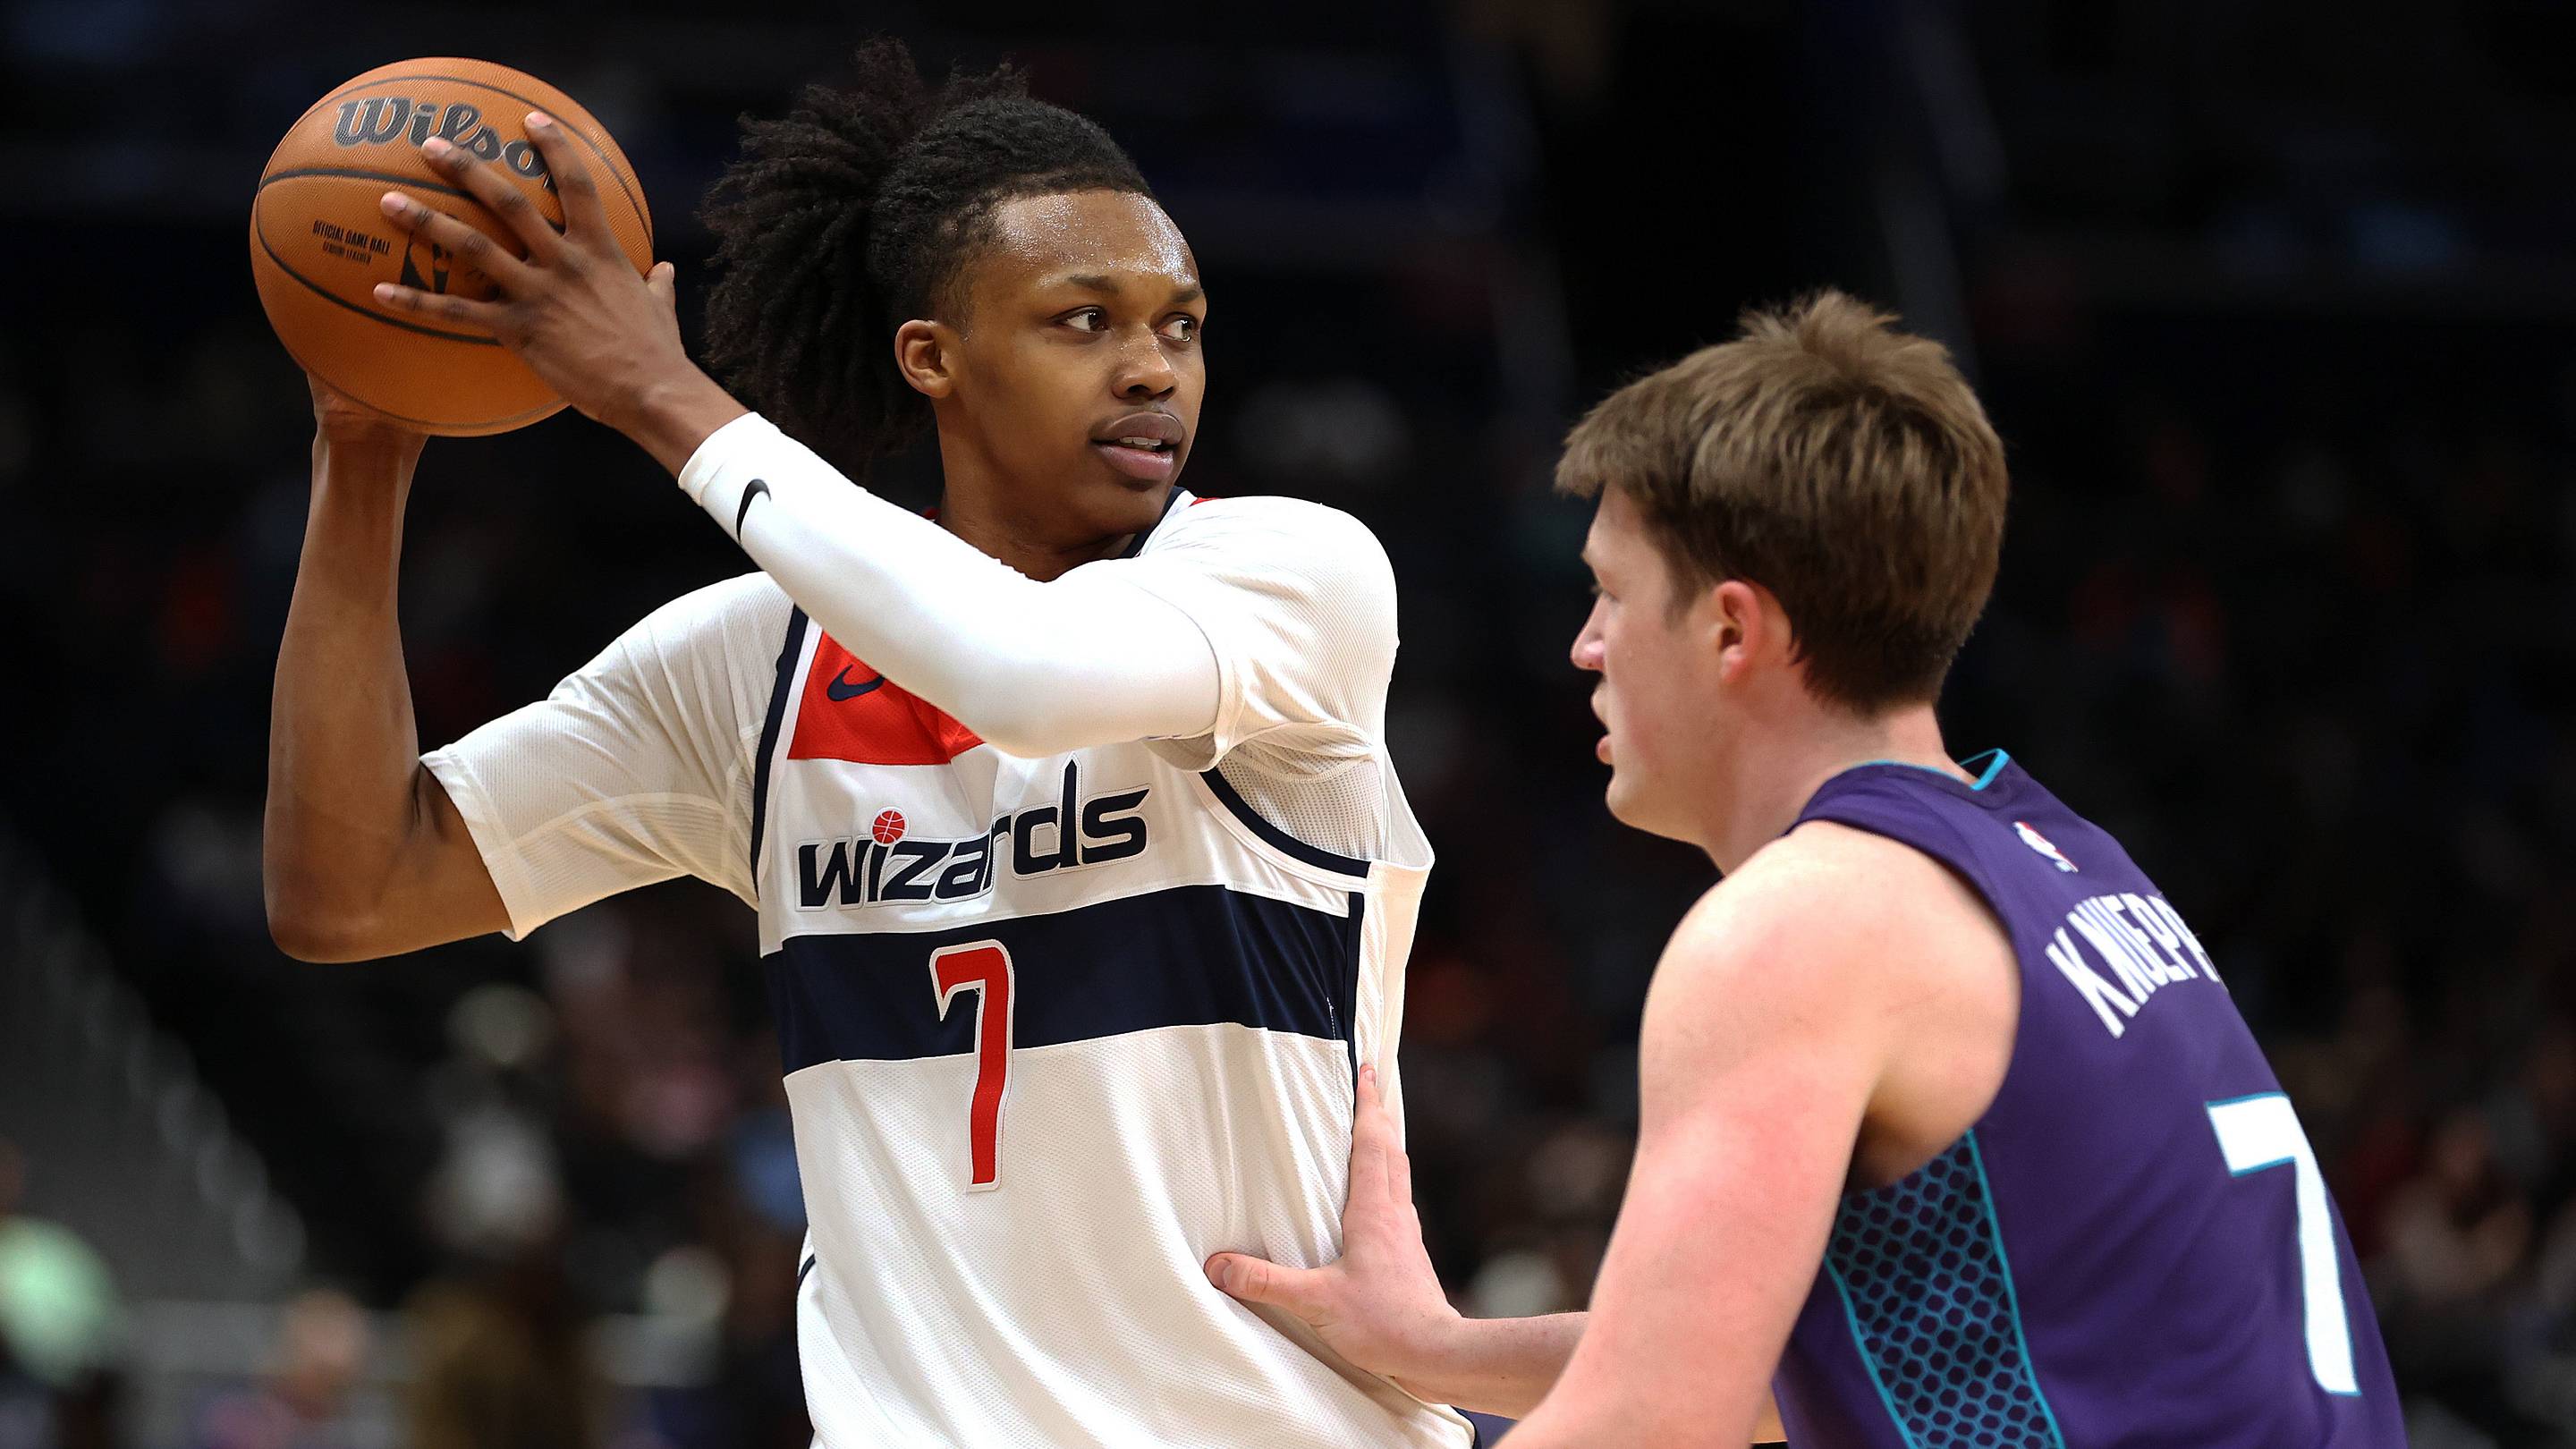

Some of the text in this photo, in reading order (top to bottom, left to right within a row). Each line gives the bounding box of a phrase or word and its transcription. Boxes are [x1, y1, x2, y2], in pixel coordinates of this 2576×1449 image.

[333, 97, 560, 196] Wilso
[312, 219, 344, 242] OFFICIAL
[344, 229, 369, 250] GAME
[369, 236, 391, 256] BALL
[796, 755, 1150, 910] wizards
[929, 939, 1014, 1192] 7
[2205, 1091, 2362, 1396] 7
